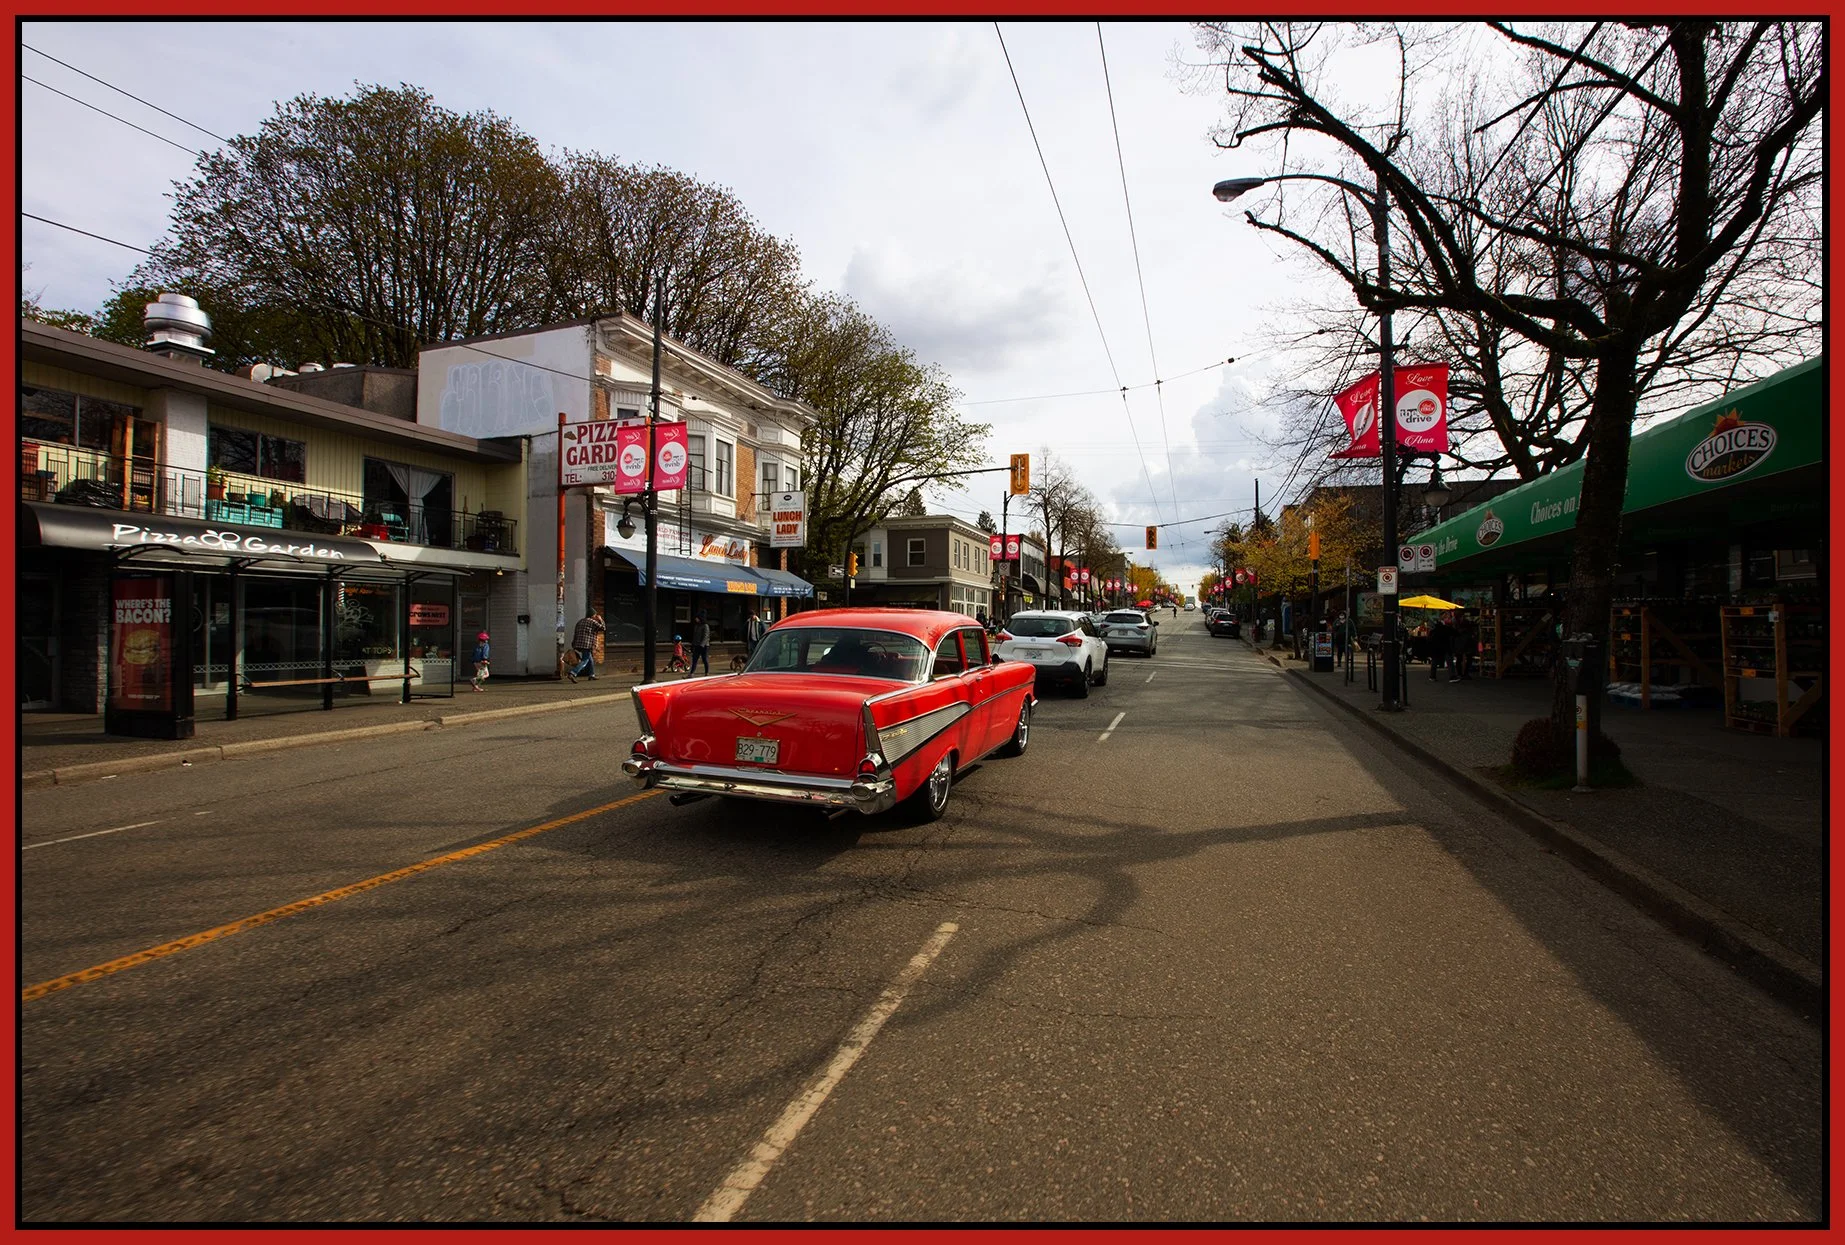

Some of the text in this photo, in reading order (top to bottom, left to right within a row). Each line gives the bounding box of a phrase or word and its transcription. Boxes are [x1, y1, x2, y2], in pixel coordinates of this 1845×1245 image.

[1406, 415, 1432, 424] drive
[577, 421, 629, 444] PIZZ
[566, 443, 617, 466] GARD
[1691, 428, 1770, 472] CHOICES
[1702, 452, 1756, 477] markets
[565, 473, 583, 484] TEL:
[772, 511, 802, 522] LUNCH
[1530, 496, 1576, 525] Choices on
[776, 523, 799, 535] LADY
[1477, 519, 1502, 539] CHOICES
[112, 523, 345, 559] Pizza Garden
[699, 533, 728, 558] Lunch
[727, 540, 748, 566] Lady
[115, 598, 171, 609] WHERE'S THE
[115, 608, 172, 624] BACON?
[737, 743, 776, 758] B29-779
